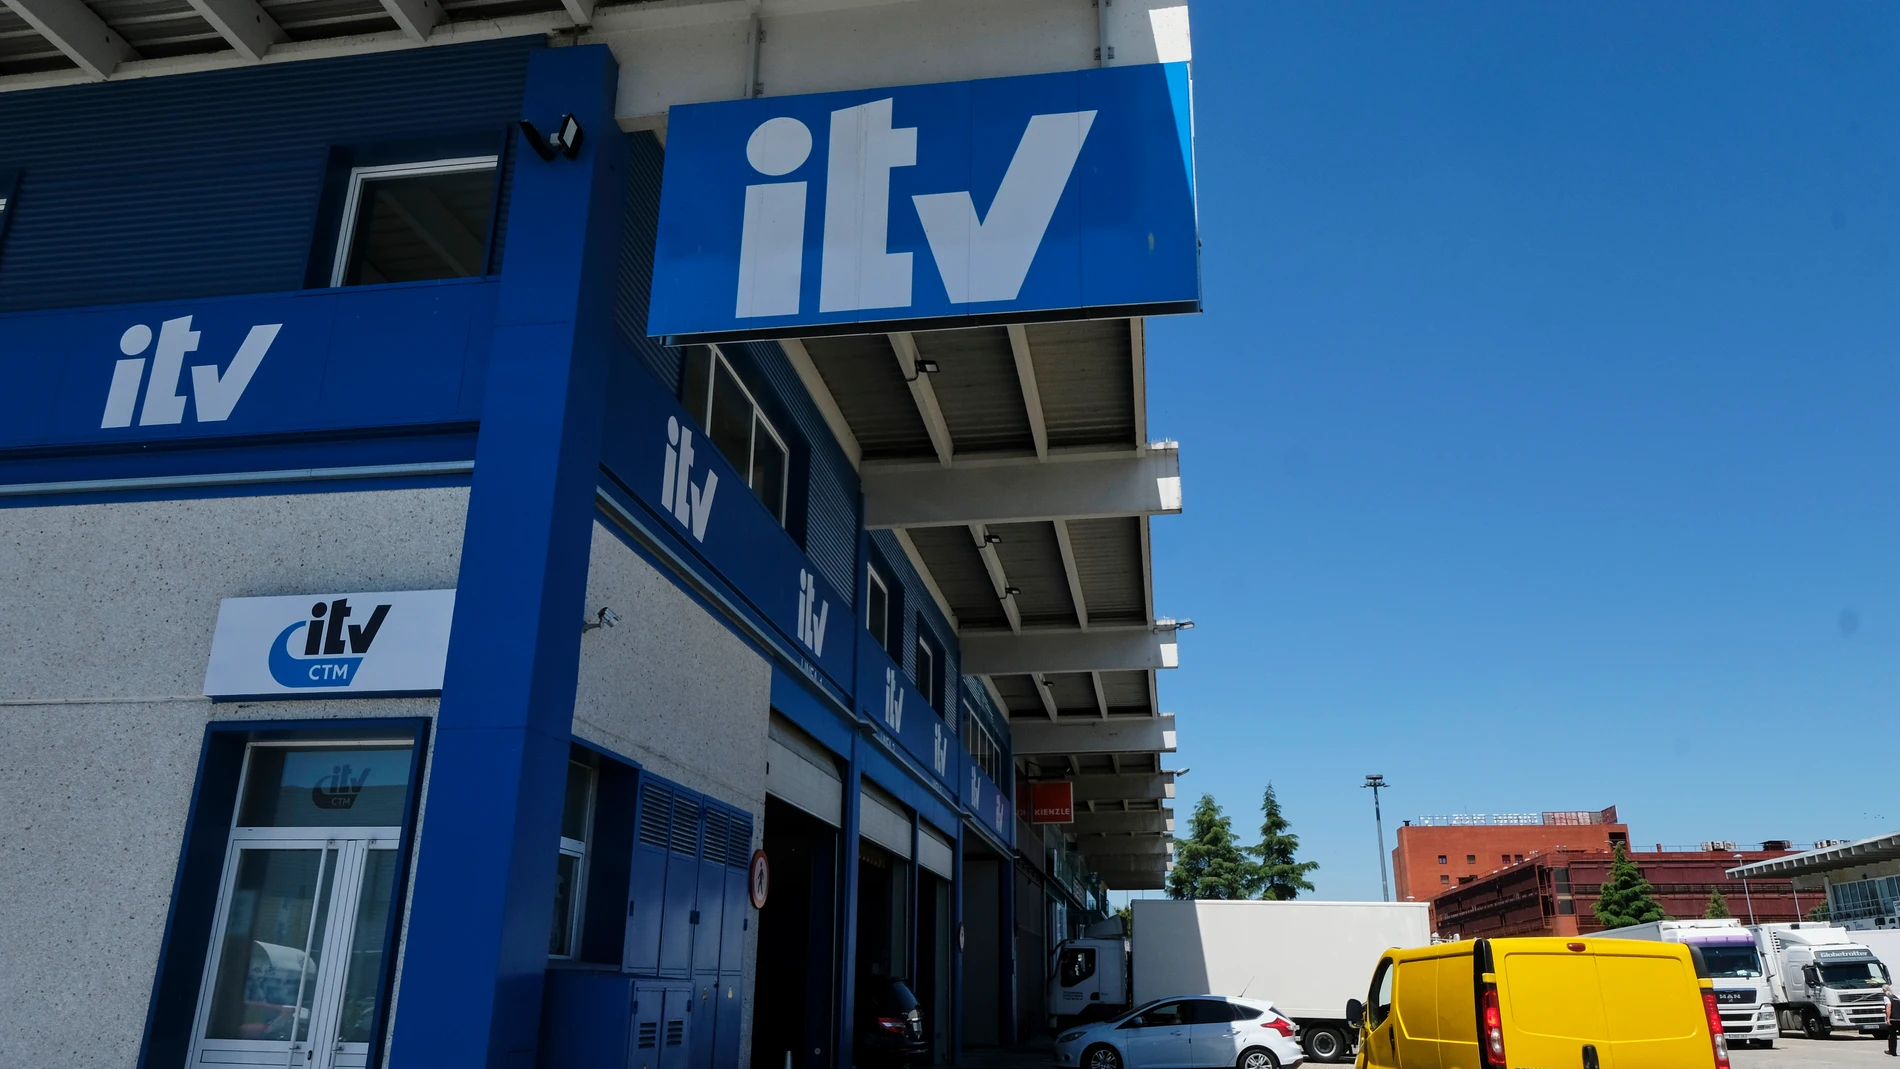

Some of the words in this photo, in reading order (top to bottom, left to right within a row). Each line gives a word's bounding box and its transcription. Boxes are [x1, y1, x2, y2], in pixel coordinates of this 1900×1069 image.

[735, 97, 1098, 318] itv
[100, 314, 283, 429] itv
[660, 415, 719, 543] itv
[304, 597, 392, 655] itv
[797, 568, 829, 657] itv
[308, 663, 348, 681] CTM
[884, 667, 904, 734] itv
[329, 764, 371, 793] itv
[331, 797, 350, 806] CTM
[1034, 808, 1070, 816] KIENZLE
